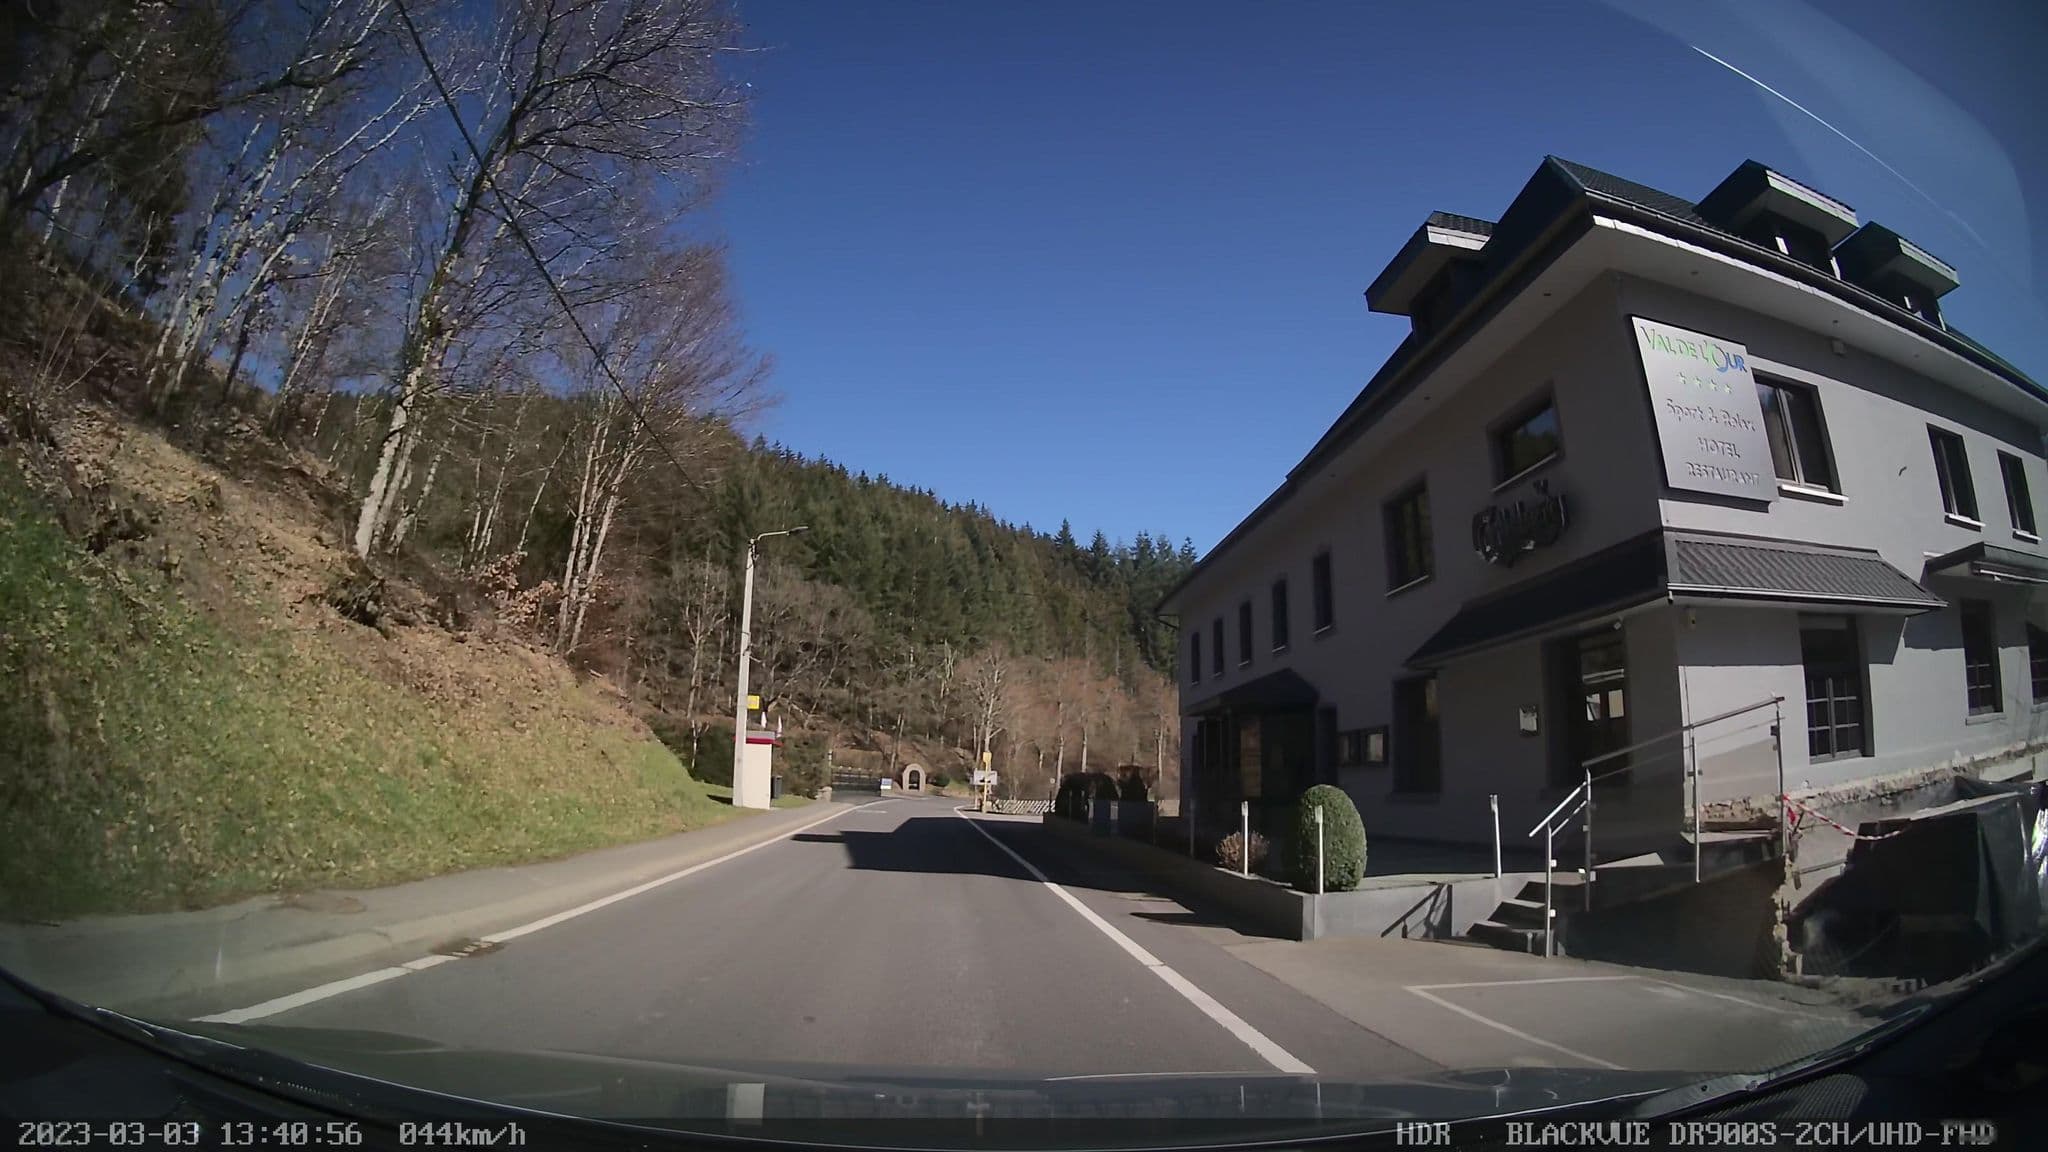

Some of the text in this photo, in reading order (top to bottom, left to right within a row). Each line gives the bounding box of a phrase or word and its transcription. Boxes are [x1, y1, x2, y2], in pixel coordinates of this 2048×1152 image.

[1640, 326, 1748, 373] VAL DE L'OUR
[1666, 398, 1704, 422] Sport
[1697, 436, 1741, 459] HOTEL
[1685, 460, 1760, 486] RESTAURANT
